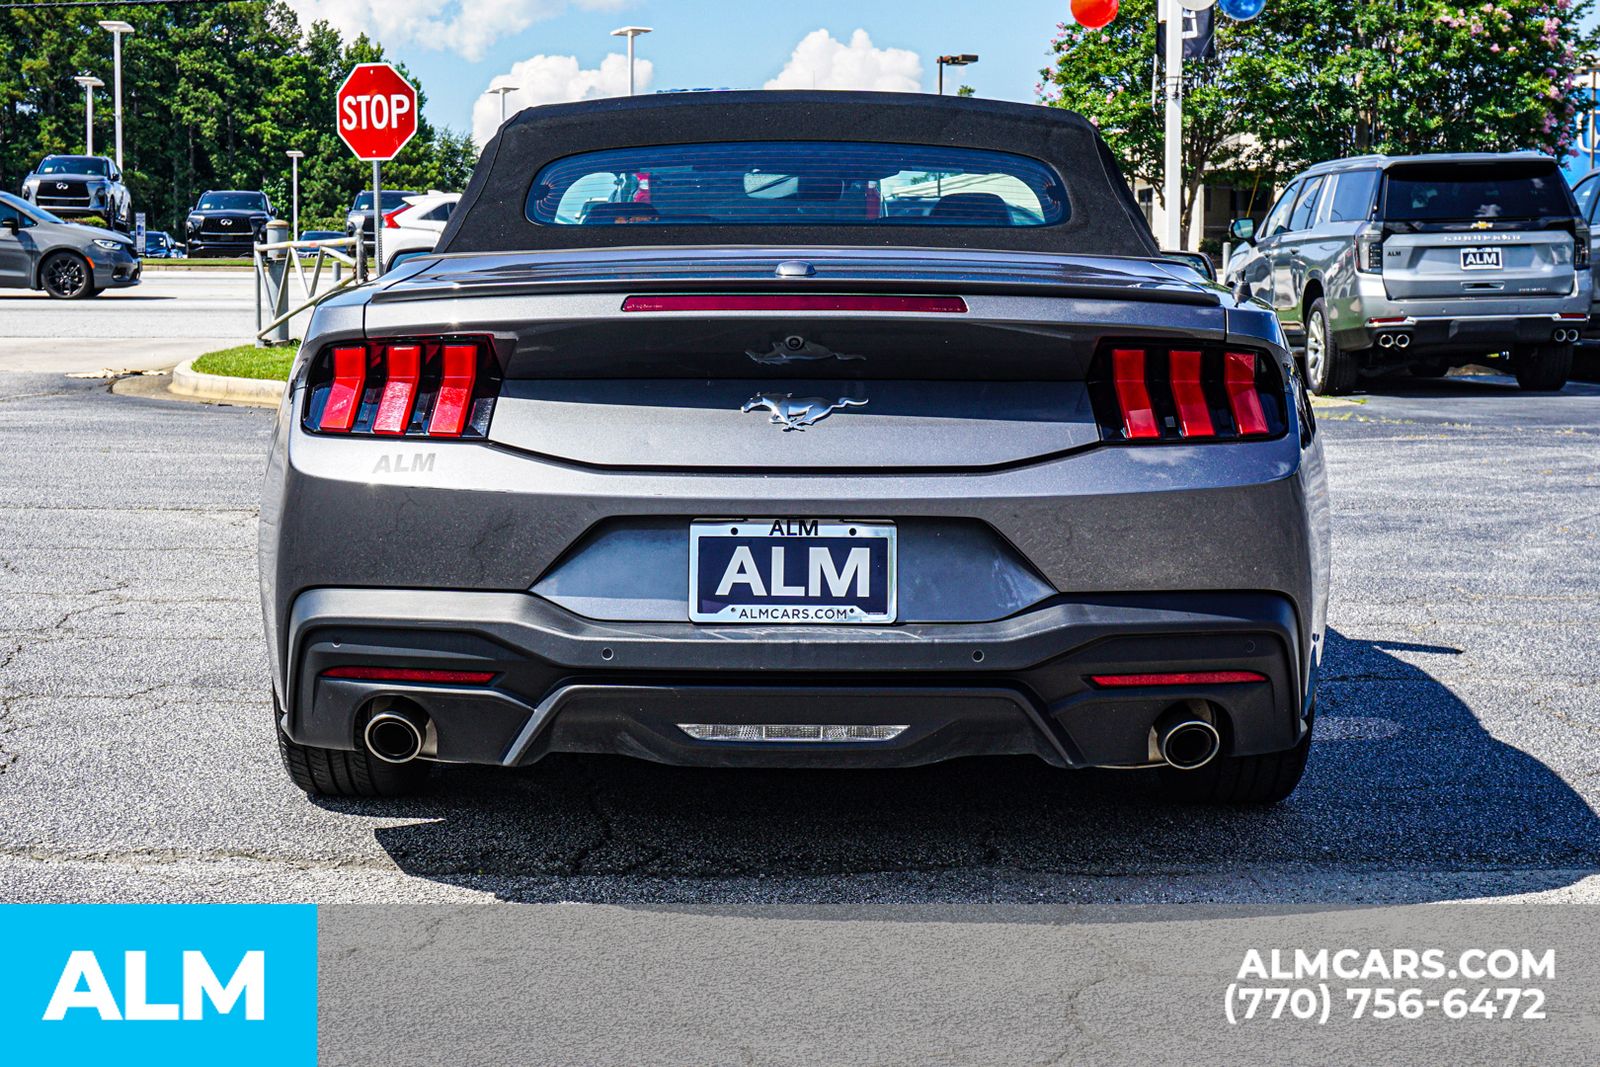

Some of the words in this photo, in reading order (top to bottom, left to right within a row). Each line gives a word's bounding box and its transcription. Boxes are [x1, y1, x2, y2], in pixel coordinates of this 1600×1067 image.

[342, 93, 410, 131] STOP
[1465, 253, 1497, 265] ALM
[372, 453, 436, 474] ALM
[769, 519, 819, 536] ALM
[714, 545, 871, 598] ALM
[739, 608, 848, 620] ALMCARS.COM
